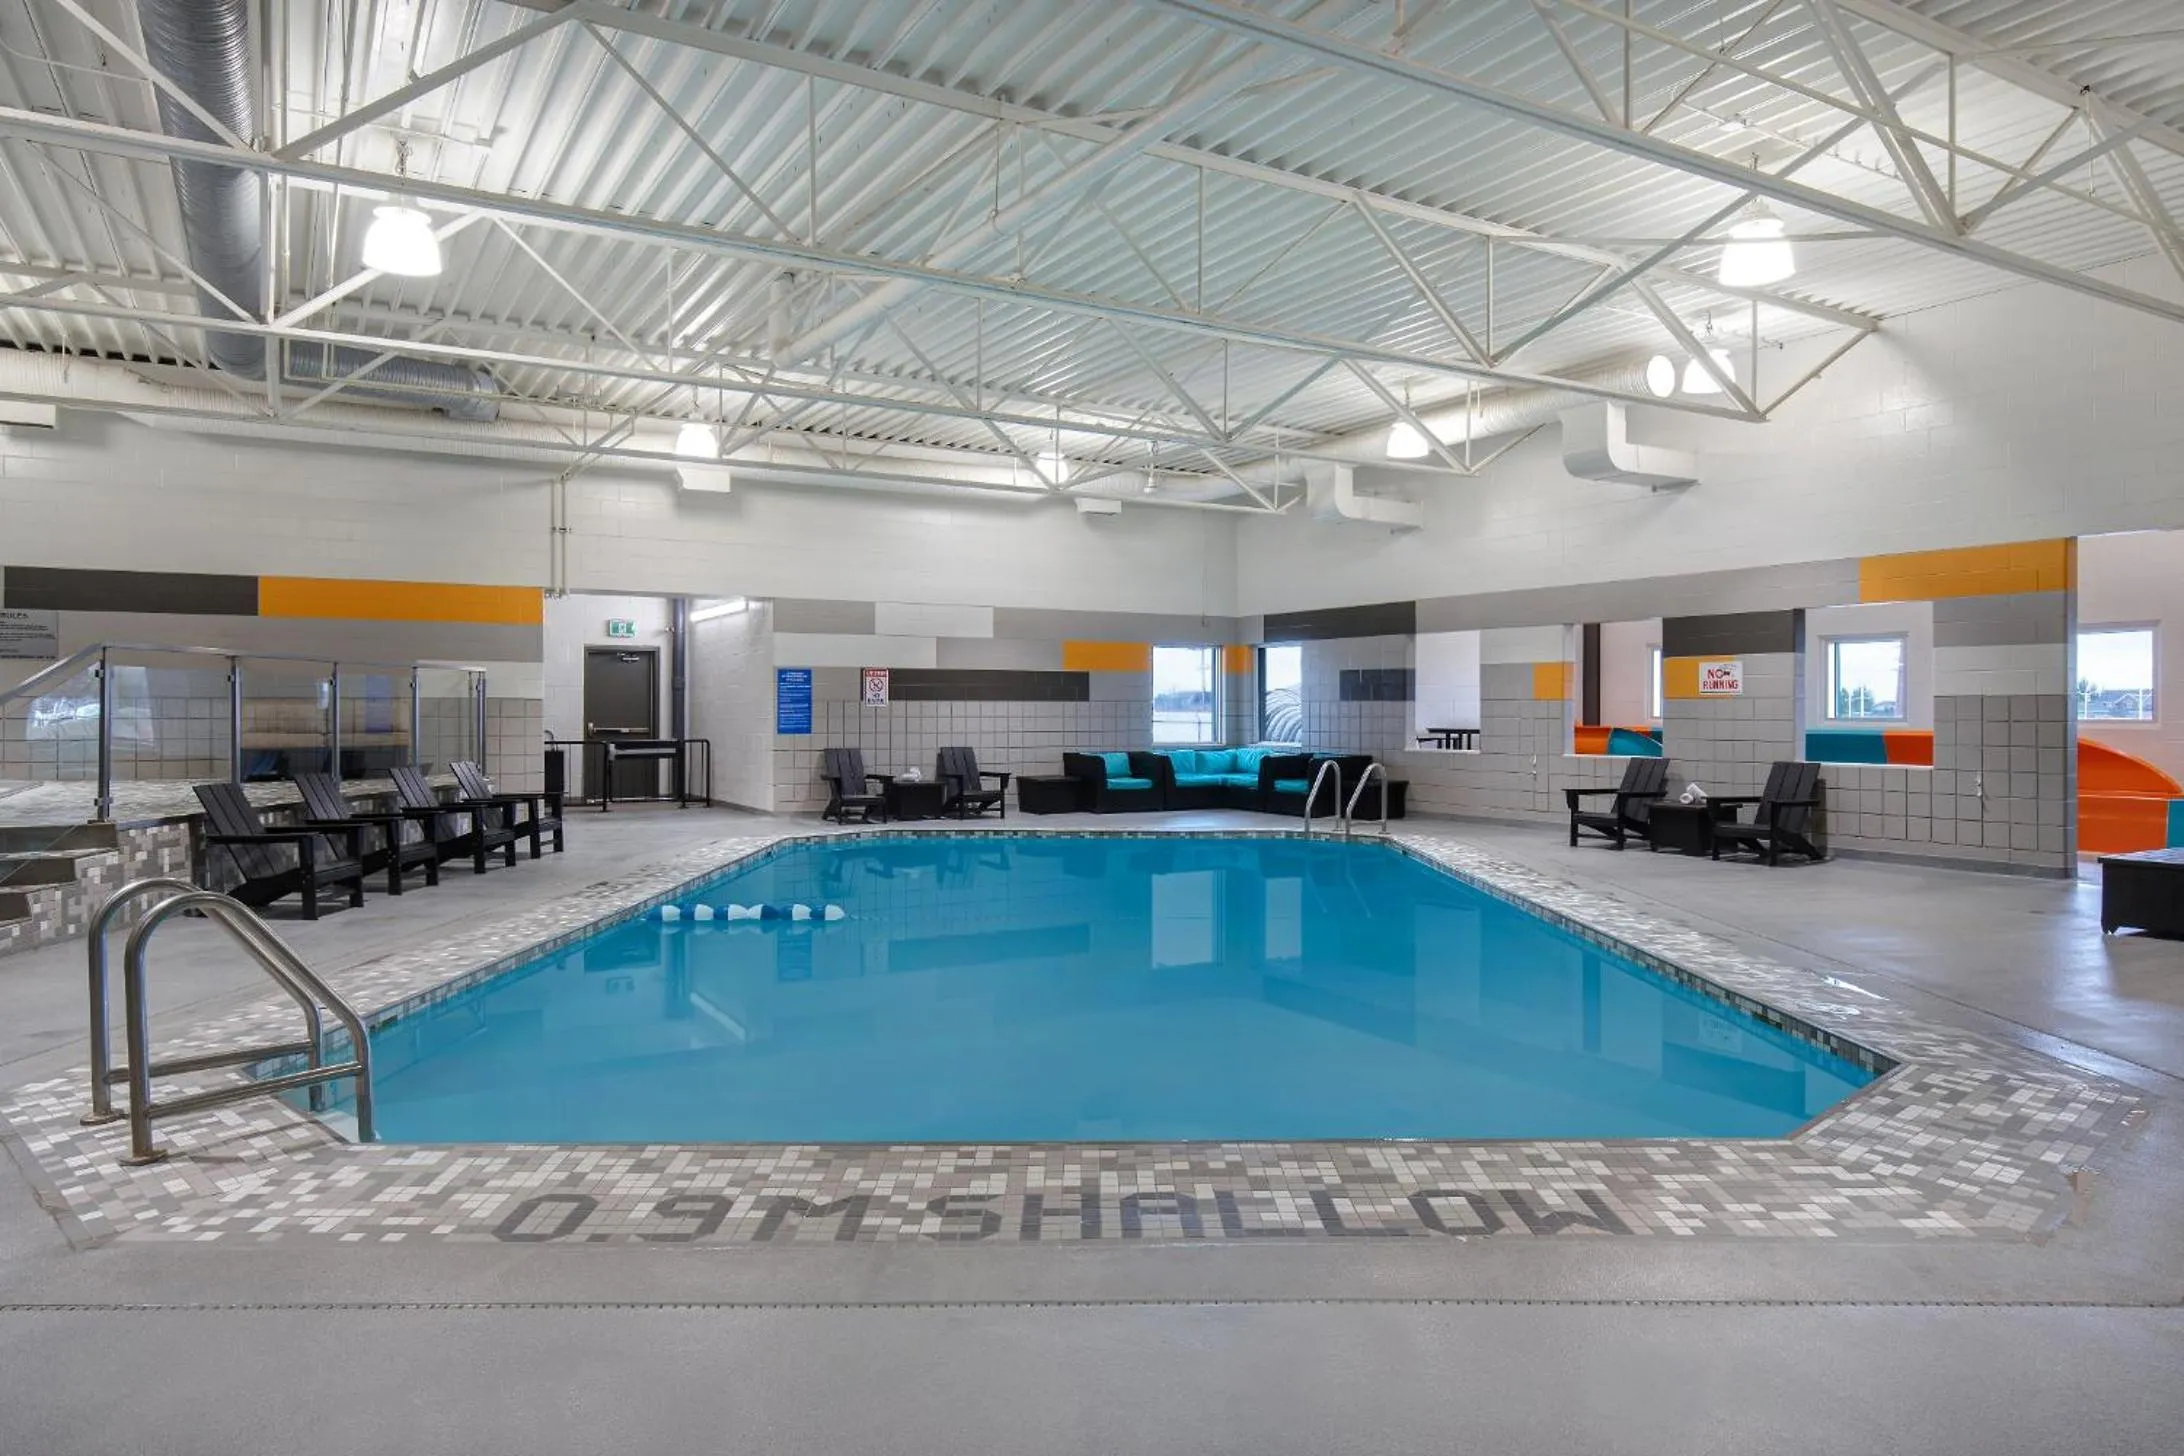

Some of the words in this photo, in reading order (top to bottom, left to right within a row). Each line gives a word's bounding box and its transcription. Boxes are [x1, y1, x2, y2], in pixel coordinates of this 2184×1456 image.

[1703, 680, 1738, 690] RUNNING
[491, 1194, 872, 1242] 0.9M
[925, 1189, 1635, 1241] SHALLOW
